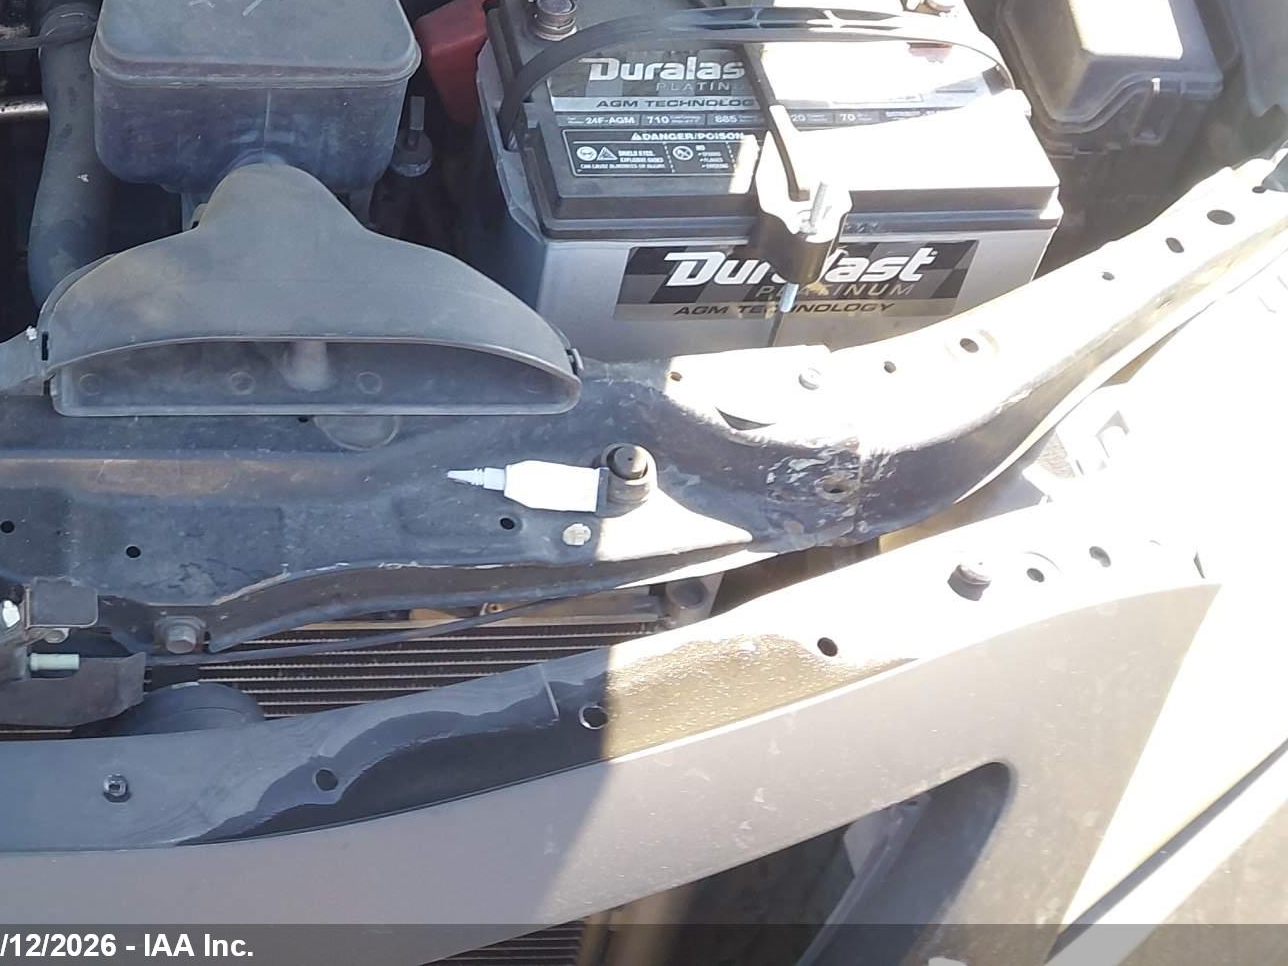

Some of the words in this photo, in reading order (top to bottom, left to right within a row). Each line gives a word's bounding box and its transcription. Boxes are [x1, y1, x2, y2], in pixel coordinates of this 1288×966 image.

[578, 56, 745, 81] Duralas
[656, 82, 730, 92] PLATIN
[596, 99, 638, 108] AGM
[644, 99, 755, 108] TECHNOLOG
[647, 115, 670, 124] 710
[755, 283, 916, 297] PINUM
[674, 305, 730, 315] AGM
[737, 302, 895, 314] TENOLOGY
